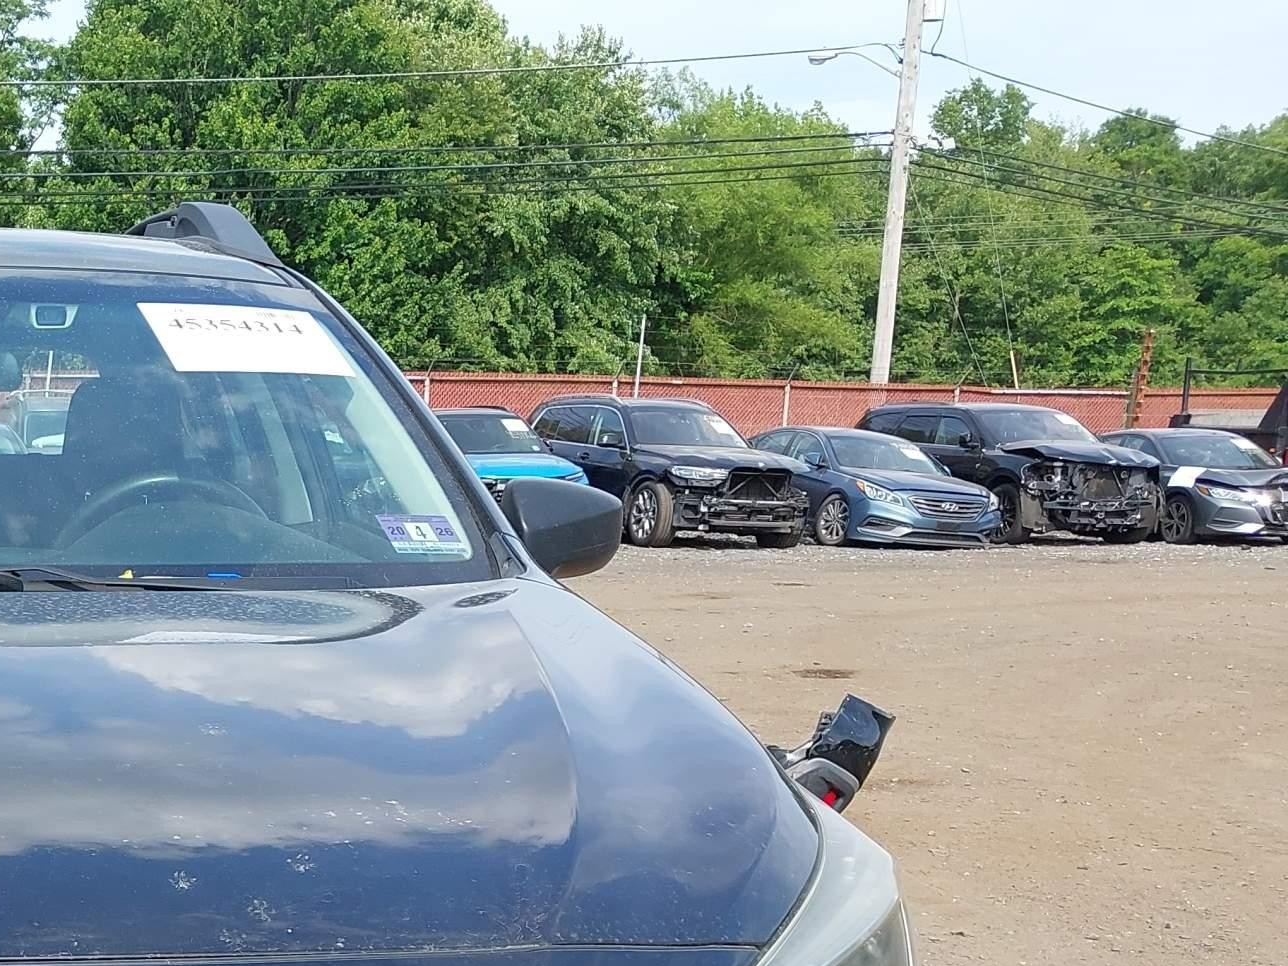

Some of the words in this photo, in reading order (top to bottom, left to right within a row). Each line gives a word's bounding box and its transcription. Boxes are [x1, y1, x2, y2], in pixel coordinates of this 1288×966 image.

[168, 317, 304, 335] 45354314
[387, 526, 405, 536] 20
[415, 525, 428, 539] 4
[435, 527, 454, 536] 26
